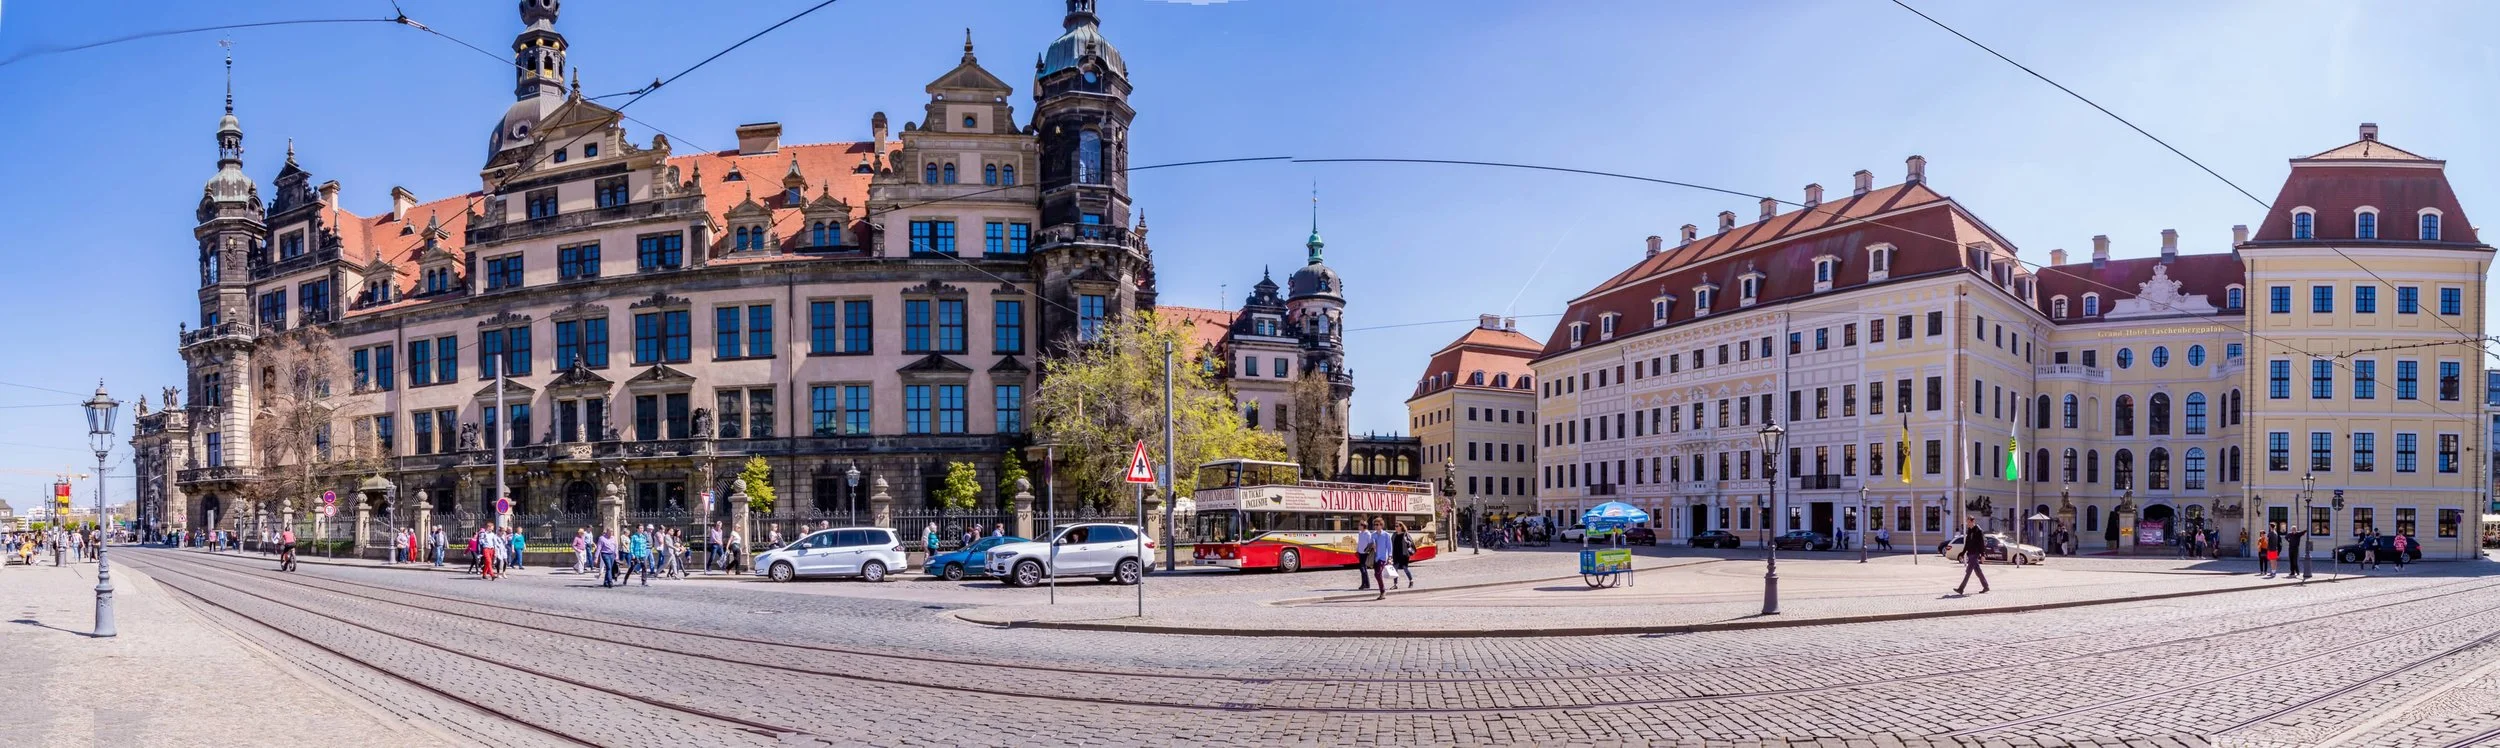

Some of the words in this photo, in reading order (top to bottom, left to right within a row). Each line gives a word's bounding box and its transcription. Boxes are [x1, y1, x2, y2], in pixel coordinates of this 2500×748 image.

[2152, 325, 2225, 335] Taschenbergpalais
[1248, 488, 1264, 499] TICKET
[1320, 489, 1409, 512] STADTRUNDFAHRT
